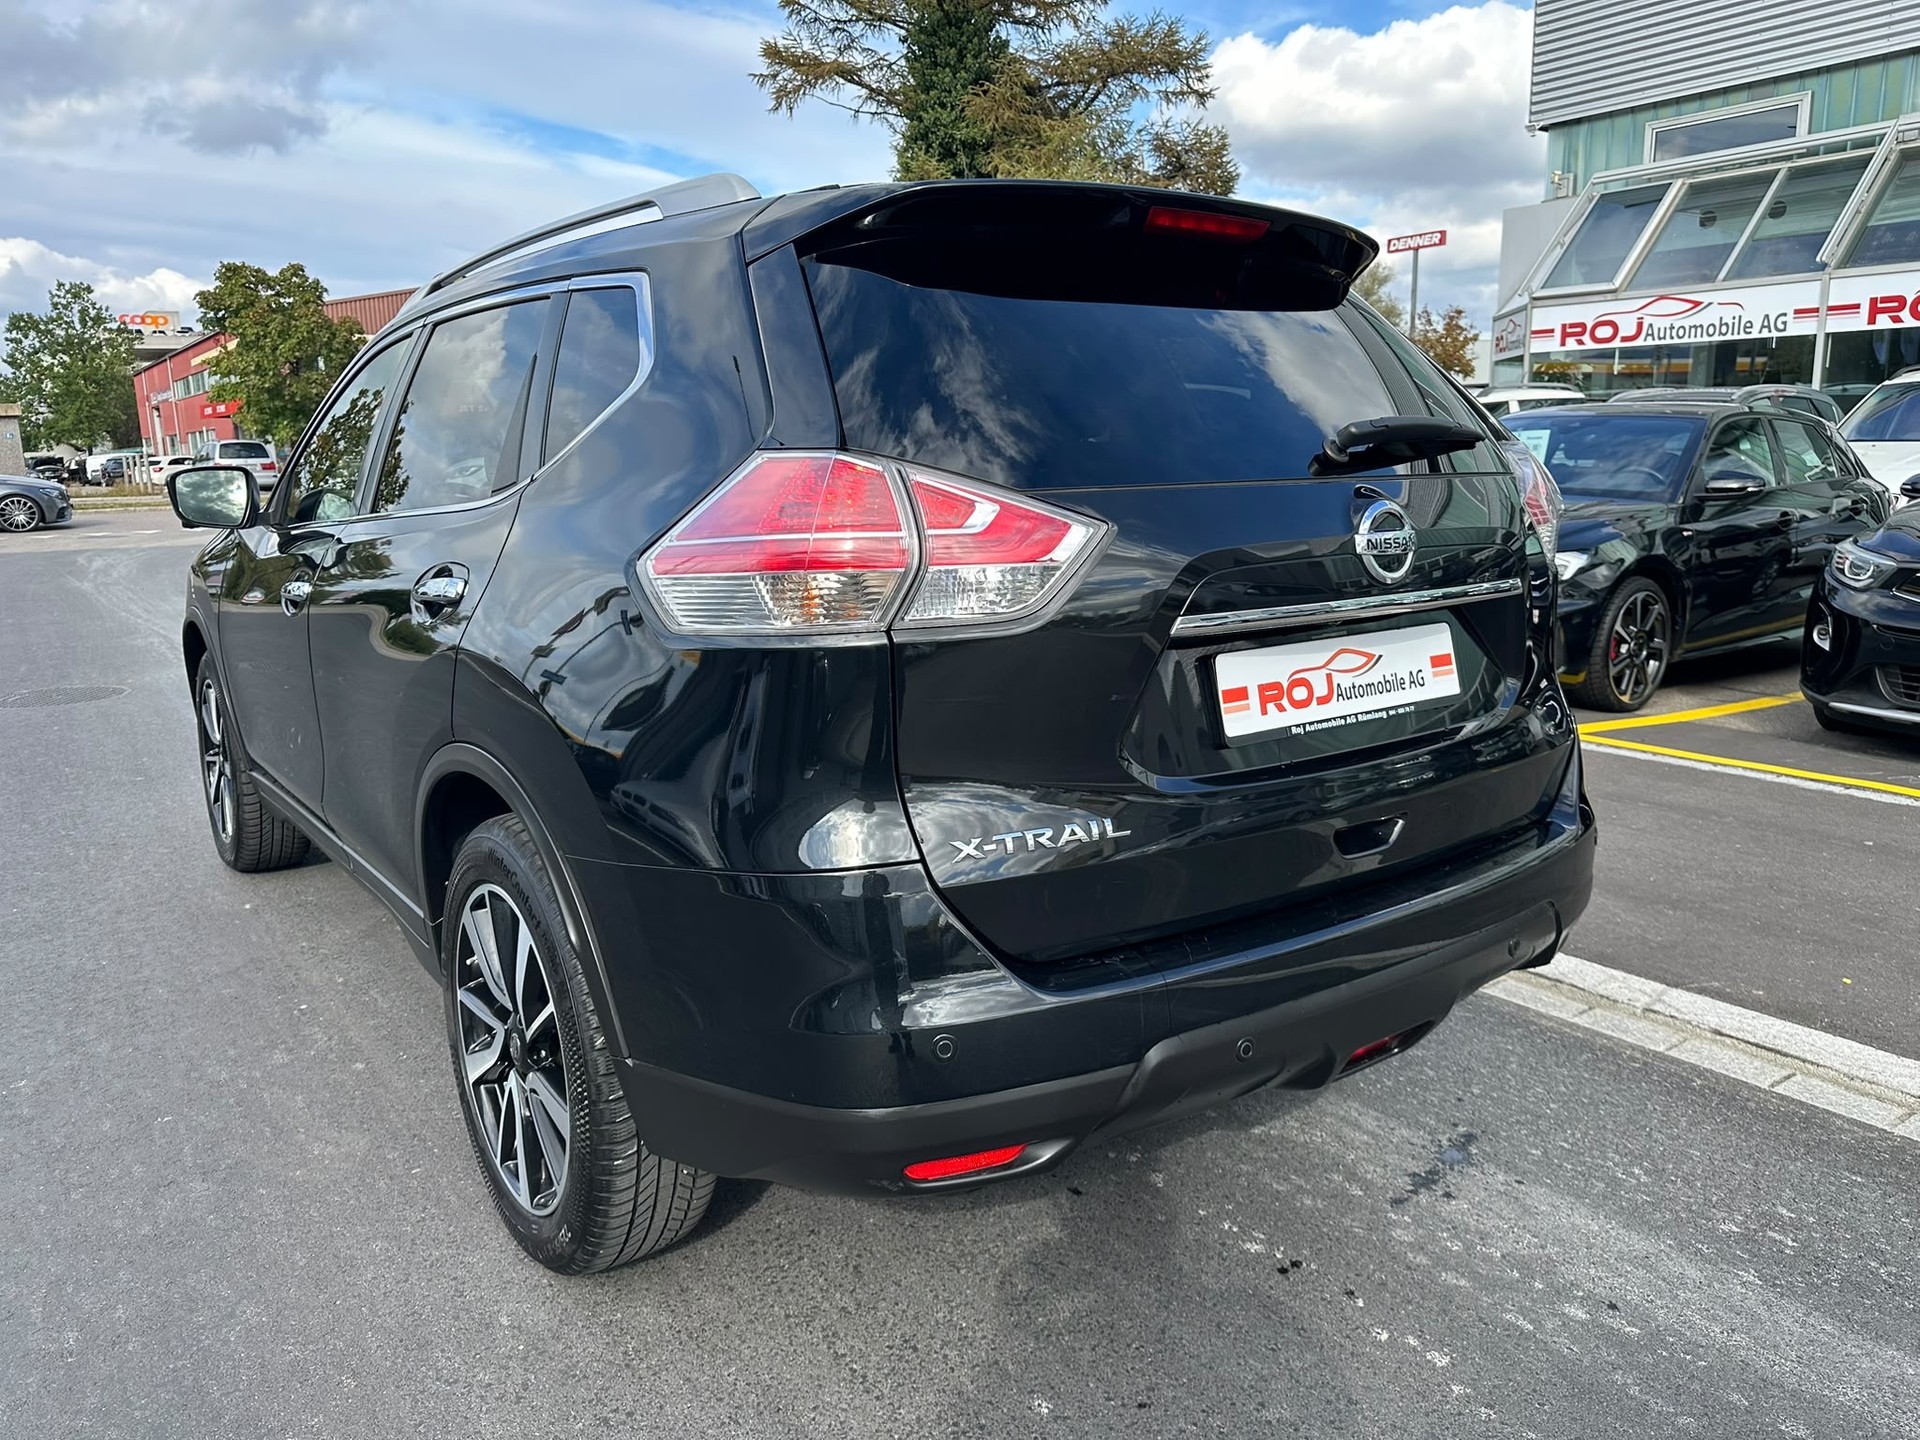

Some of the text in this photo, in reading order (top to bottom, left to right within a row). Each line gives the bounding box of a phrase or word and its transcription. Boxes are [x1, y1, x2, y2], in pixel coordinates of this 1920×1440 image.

[1389, 232, 1442, 251] DENNER
[1867, 295, 1920, 325] R
[1560, 312, 1788, 347] ROJ Automobile AG
[1257, 669, 1425, 716] ROJ Automobile AG
[1291, 725, 1304, 735] Roj
[1305, 717, 1345, 732] Automobile
[1346, 715, 1357, 724] AG
[949, 817, 1132, 863] X-TRAIL
